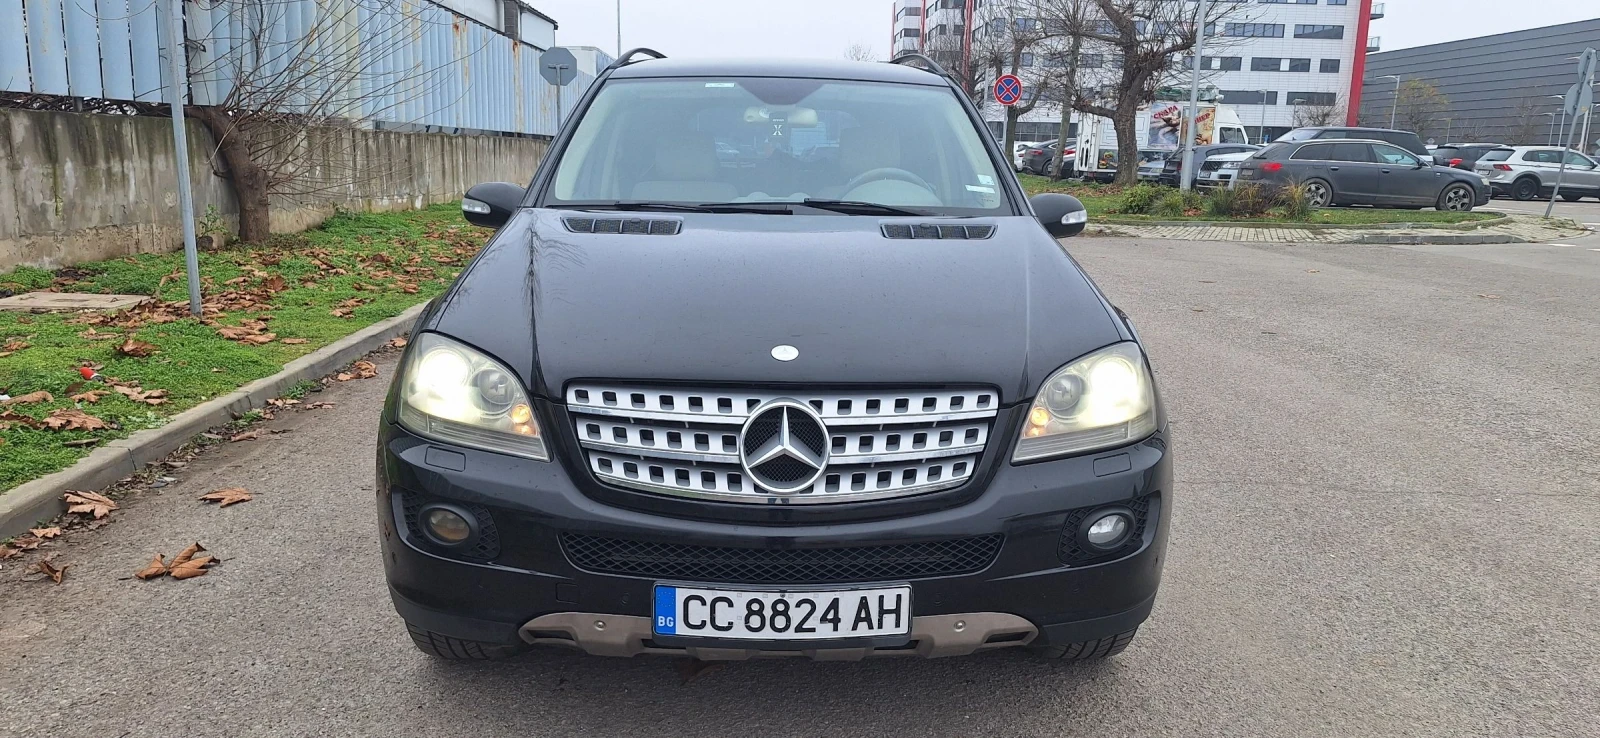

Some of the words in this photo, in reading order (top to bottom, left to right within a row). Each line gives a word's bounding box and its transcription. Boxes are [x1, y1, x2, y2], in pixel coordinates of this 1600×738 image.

[658, 615, 674, 627] BG
[683, 594, 734, 632] CC
[744, 598, 841, 633] 8824
[851, 594, 902, 631] AH
